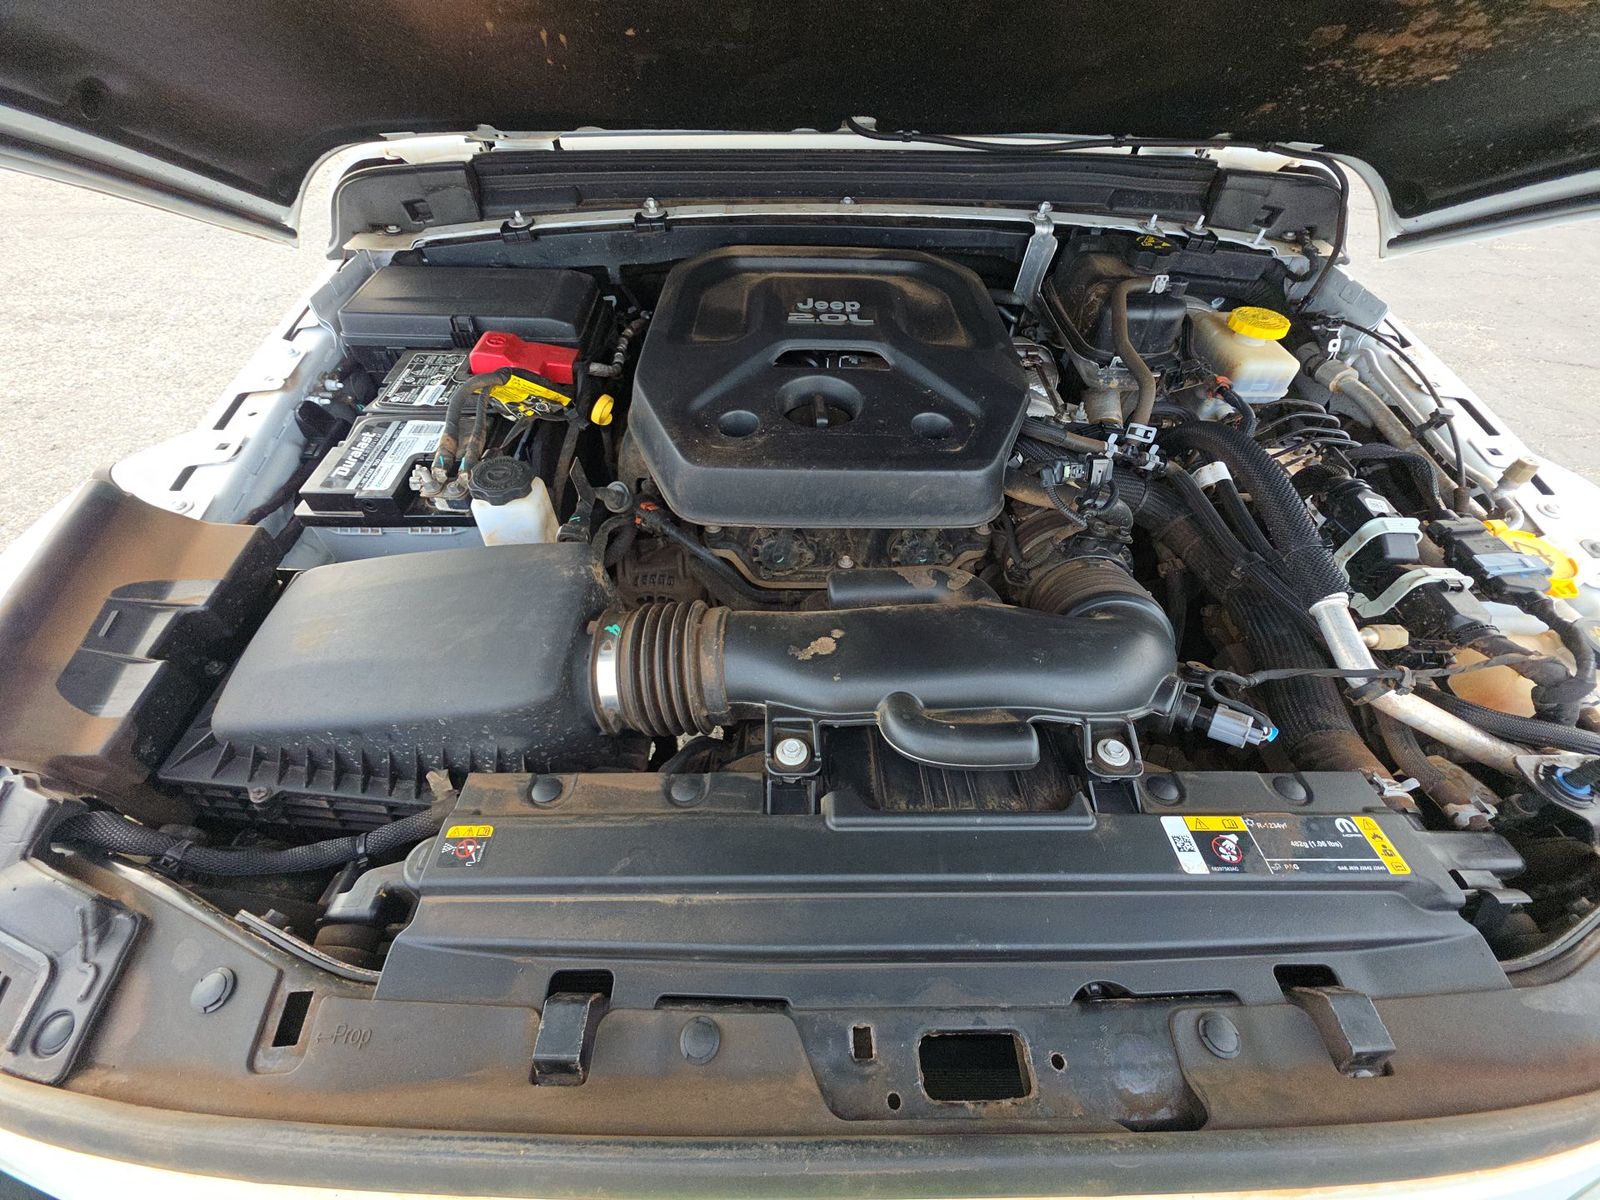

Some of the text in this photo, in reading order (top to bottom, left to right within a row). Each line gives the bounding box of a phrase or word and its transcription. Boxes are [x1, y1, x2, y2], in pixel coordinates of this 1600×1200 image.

[796, 298, 861, 312] Jeep
[787, 312, 875, 325] 2.0L
[330, 431, 377, 478] Duralast
[331, 1023, 373, 1050] Prop
